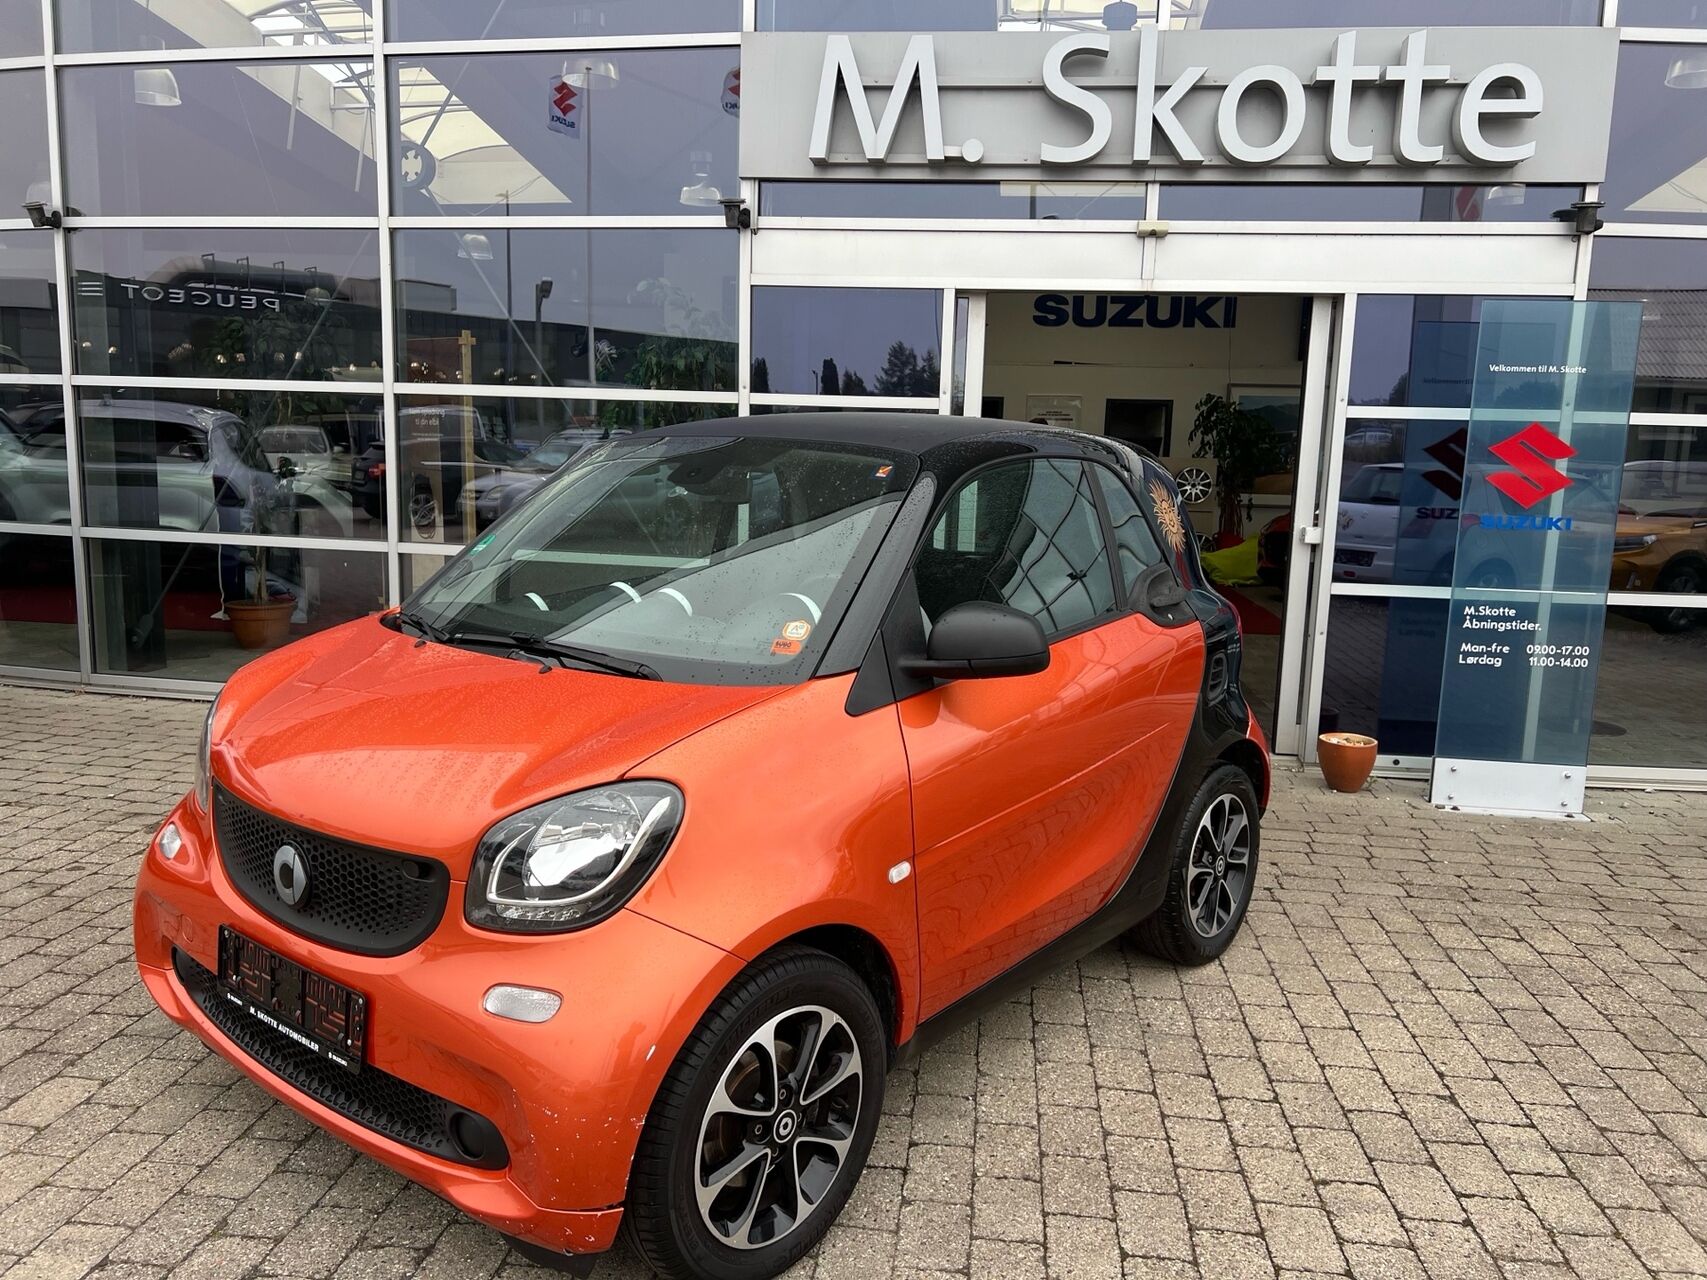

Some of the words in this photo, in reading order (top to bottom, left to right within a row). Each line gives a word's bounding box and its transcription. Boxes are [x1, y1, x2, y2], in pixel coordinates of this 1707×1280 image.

[808, 33, 985, 167] M.
[1038, 24, 1545, 168] Skotte
[1032, 293, 1238, 328] SUZUKI
[1489, 364, 1537, 373] Velkommen
[1538, 364, 1547, 373] til
[1548, 365, 1559, 373] M.
[1560, 365, 1587, 374] Skotte
[1479, 513, 1572, 531] SUZUKI
[1463, 605, 1517, 617] M.Skotte
[1462, 615, 1542, 632] Åbningstider.
[1460, 642, 1510, 654] Man-fre
[1458, 654, 1503, 667] Lørdag
[1529, 656, 1589, 668] 11.00-14.00
[278, 1023, 319, 1052] AUTOMOBILER
